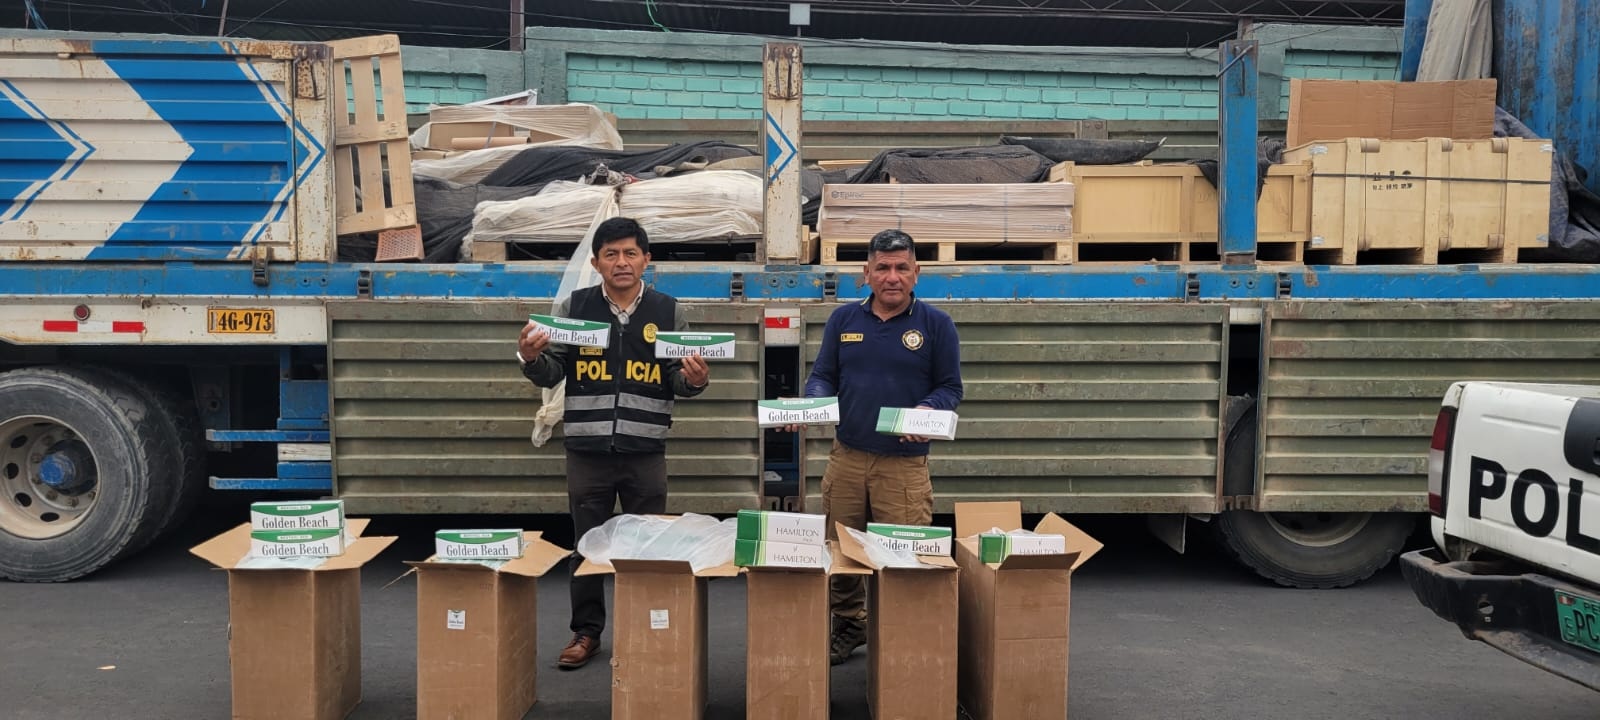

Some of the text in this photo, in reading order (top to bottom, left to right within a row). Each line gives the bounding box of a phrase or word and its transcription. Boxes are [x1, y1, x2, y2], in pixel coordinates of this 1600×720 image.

[571, 331, 598, 345] Beach
[665, 345, 726, 357] Golden Beach
[768, 409, 830, 421] Golden Beach
[909, 419, 945, 428] HAMILTON
[262, 515, 329, 528] Golden Beach
[776, 527, 819, 537] HAMILTON
[262, 543, 329, 555] Golden Beach
[446, 544, 509, 556] Golden Beach
[912, 540, 941, 553] Beach
[773, 553, 817, 564] HAMILTON
